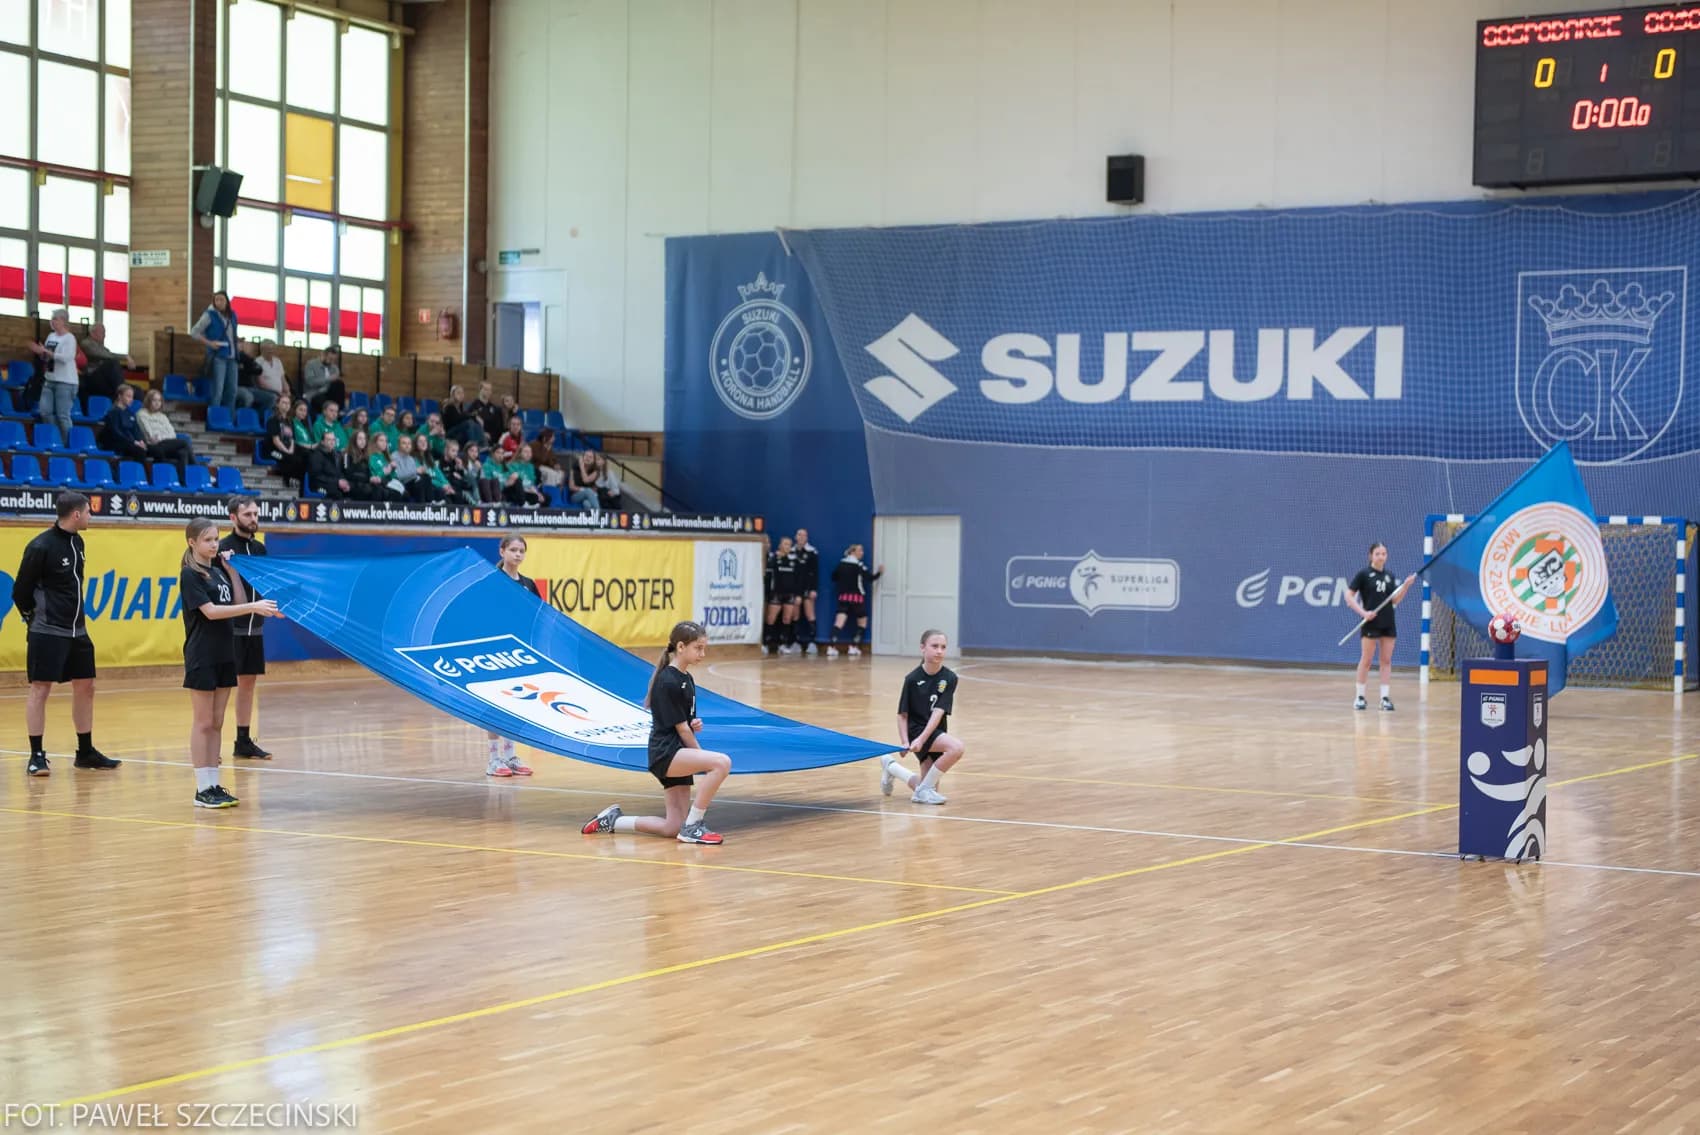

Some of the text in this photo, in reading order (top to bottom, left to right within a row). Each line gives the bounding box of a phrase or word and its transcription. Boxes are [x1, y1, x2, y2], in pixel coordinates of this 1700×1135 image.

[1534, 57, 1556, 88] 0
[1600, 63, 1608, 83] 1
[1654, 48, 1676, 79] 0
[742, 308, 780, 324] SUZUKI
[979, 325, 1404, 404] SUZUKI
[720, 368, 800, 409] KORONA HANDBALL
[1532, 346, 1652, 441] CK
[343, 503, 459, 525] www.koronahandball.pl
[509, 510, 609, 527] www.koronahandball.pl
[652, 515, 742, 532] www.koronahandball.pl
[1493, 528, 1521, 562] MKS
[1026, 575, 1067, 589] PGNiG
[1110, 574, 1169, 584] SUPERLIGA
[1277, 576, 1362, 606] PGN
[549, 578, 675, 613] KOLPORTER
[455, 648, 539, 674] PGNiG
